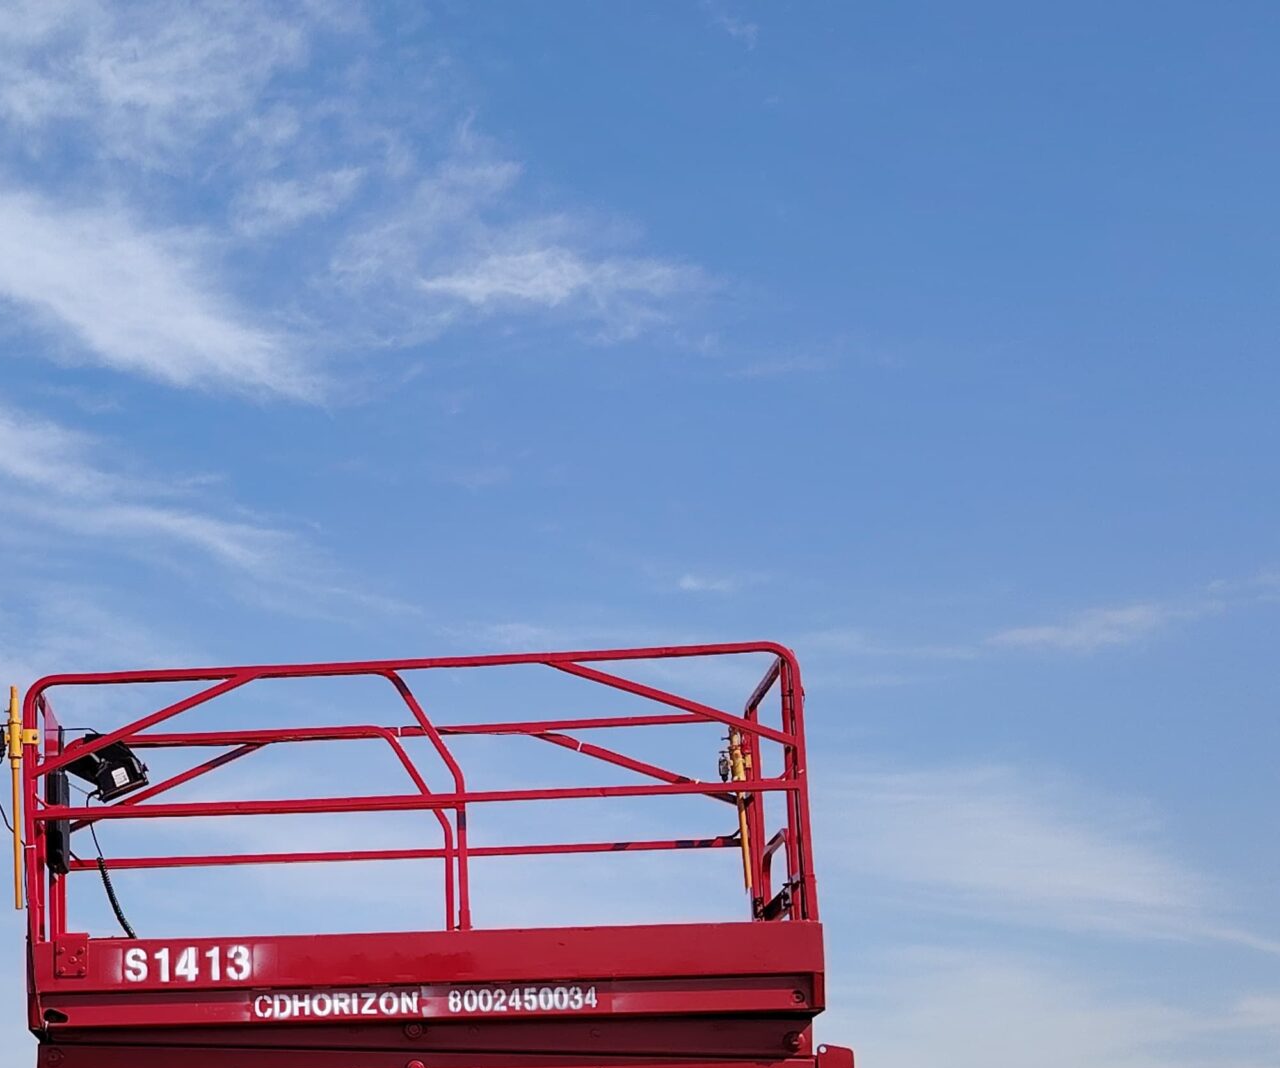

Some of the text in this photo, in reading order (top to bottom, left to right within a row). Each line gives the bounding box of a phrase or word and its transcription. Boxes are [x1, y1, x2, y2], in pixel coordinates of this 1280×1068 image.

[125, 945, 252, 982] S1413
[254, 987, 598, 1018] CDHORIZON 8002450034
